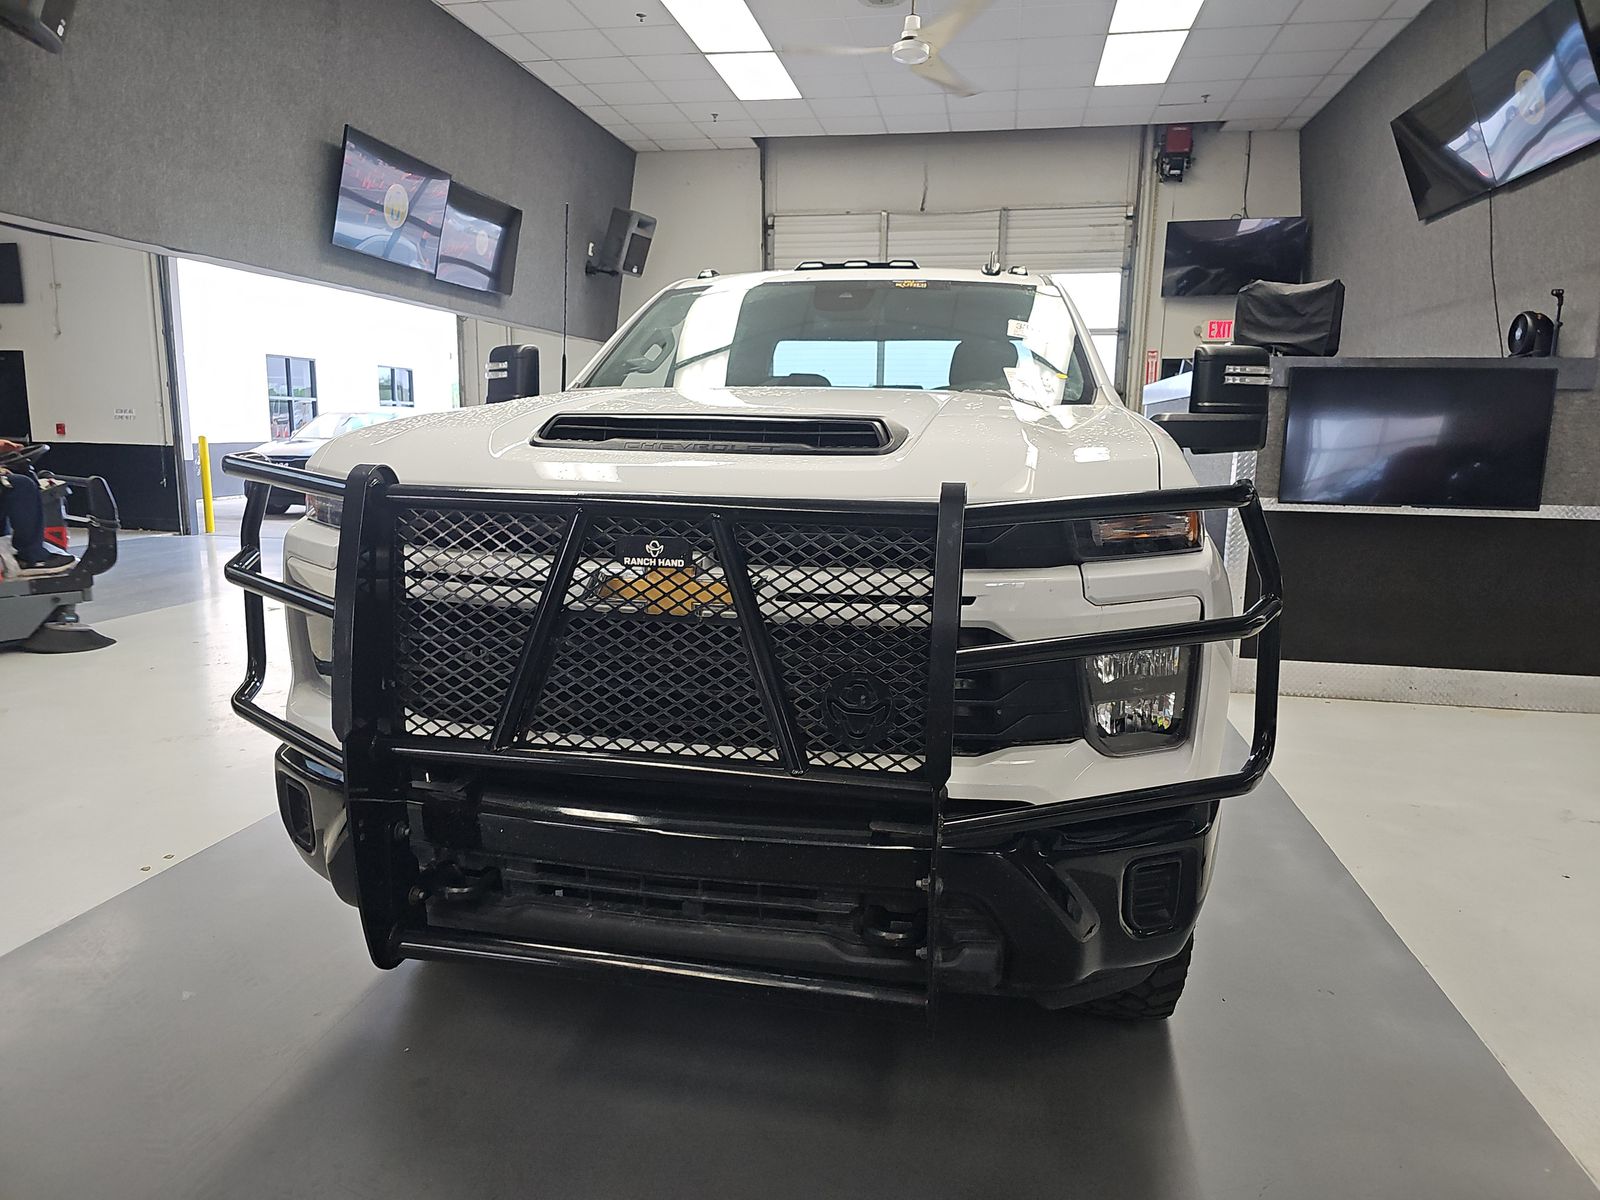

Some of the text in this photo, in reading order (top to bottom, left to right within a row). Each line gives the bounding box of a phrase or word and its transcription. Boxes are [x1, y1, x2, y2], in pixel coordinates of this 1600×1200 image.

[1208, 320, 1233, 338] EXIT
[624, 441, 781, 453] CHEVROLET
[623, 556, 685, 568] RANCH HAND
